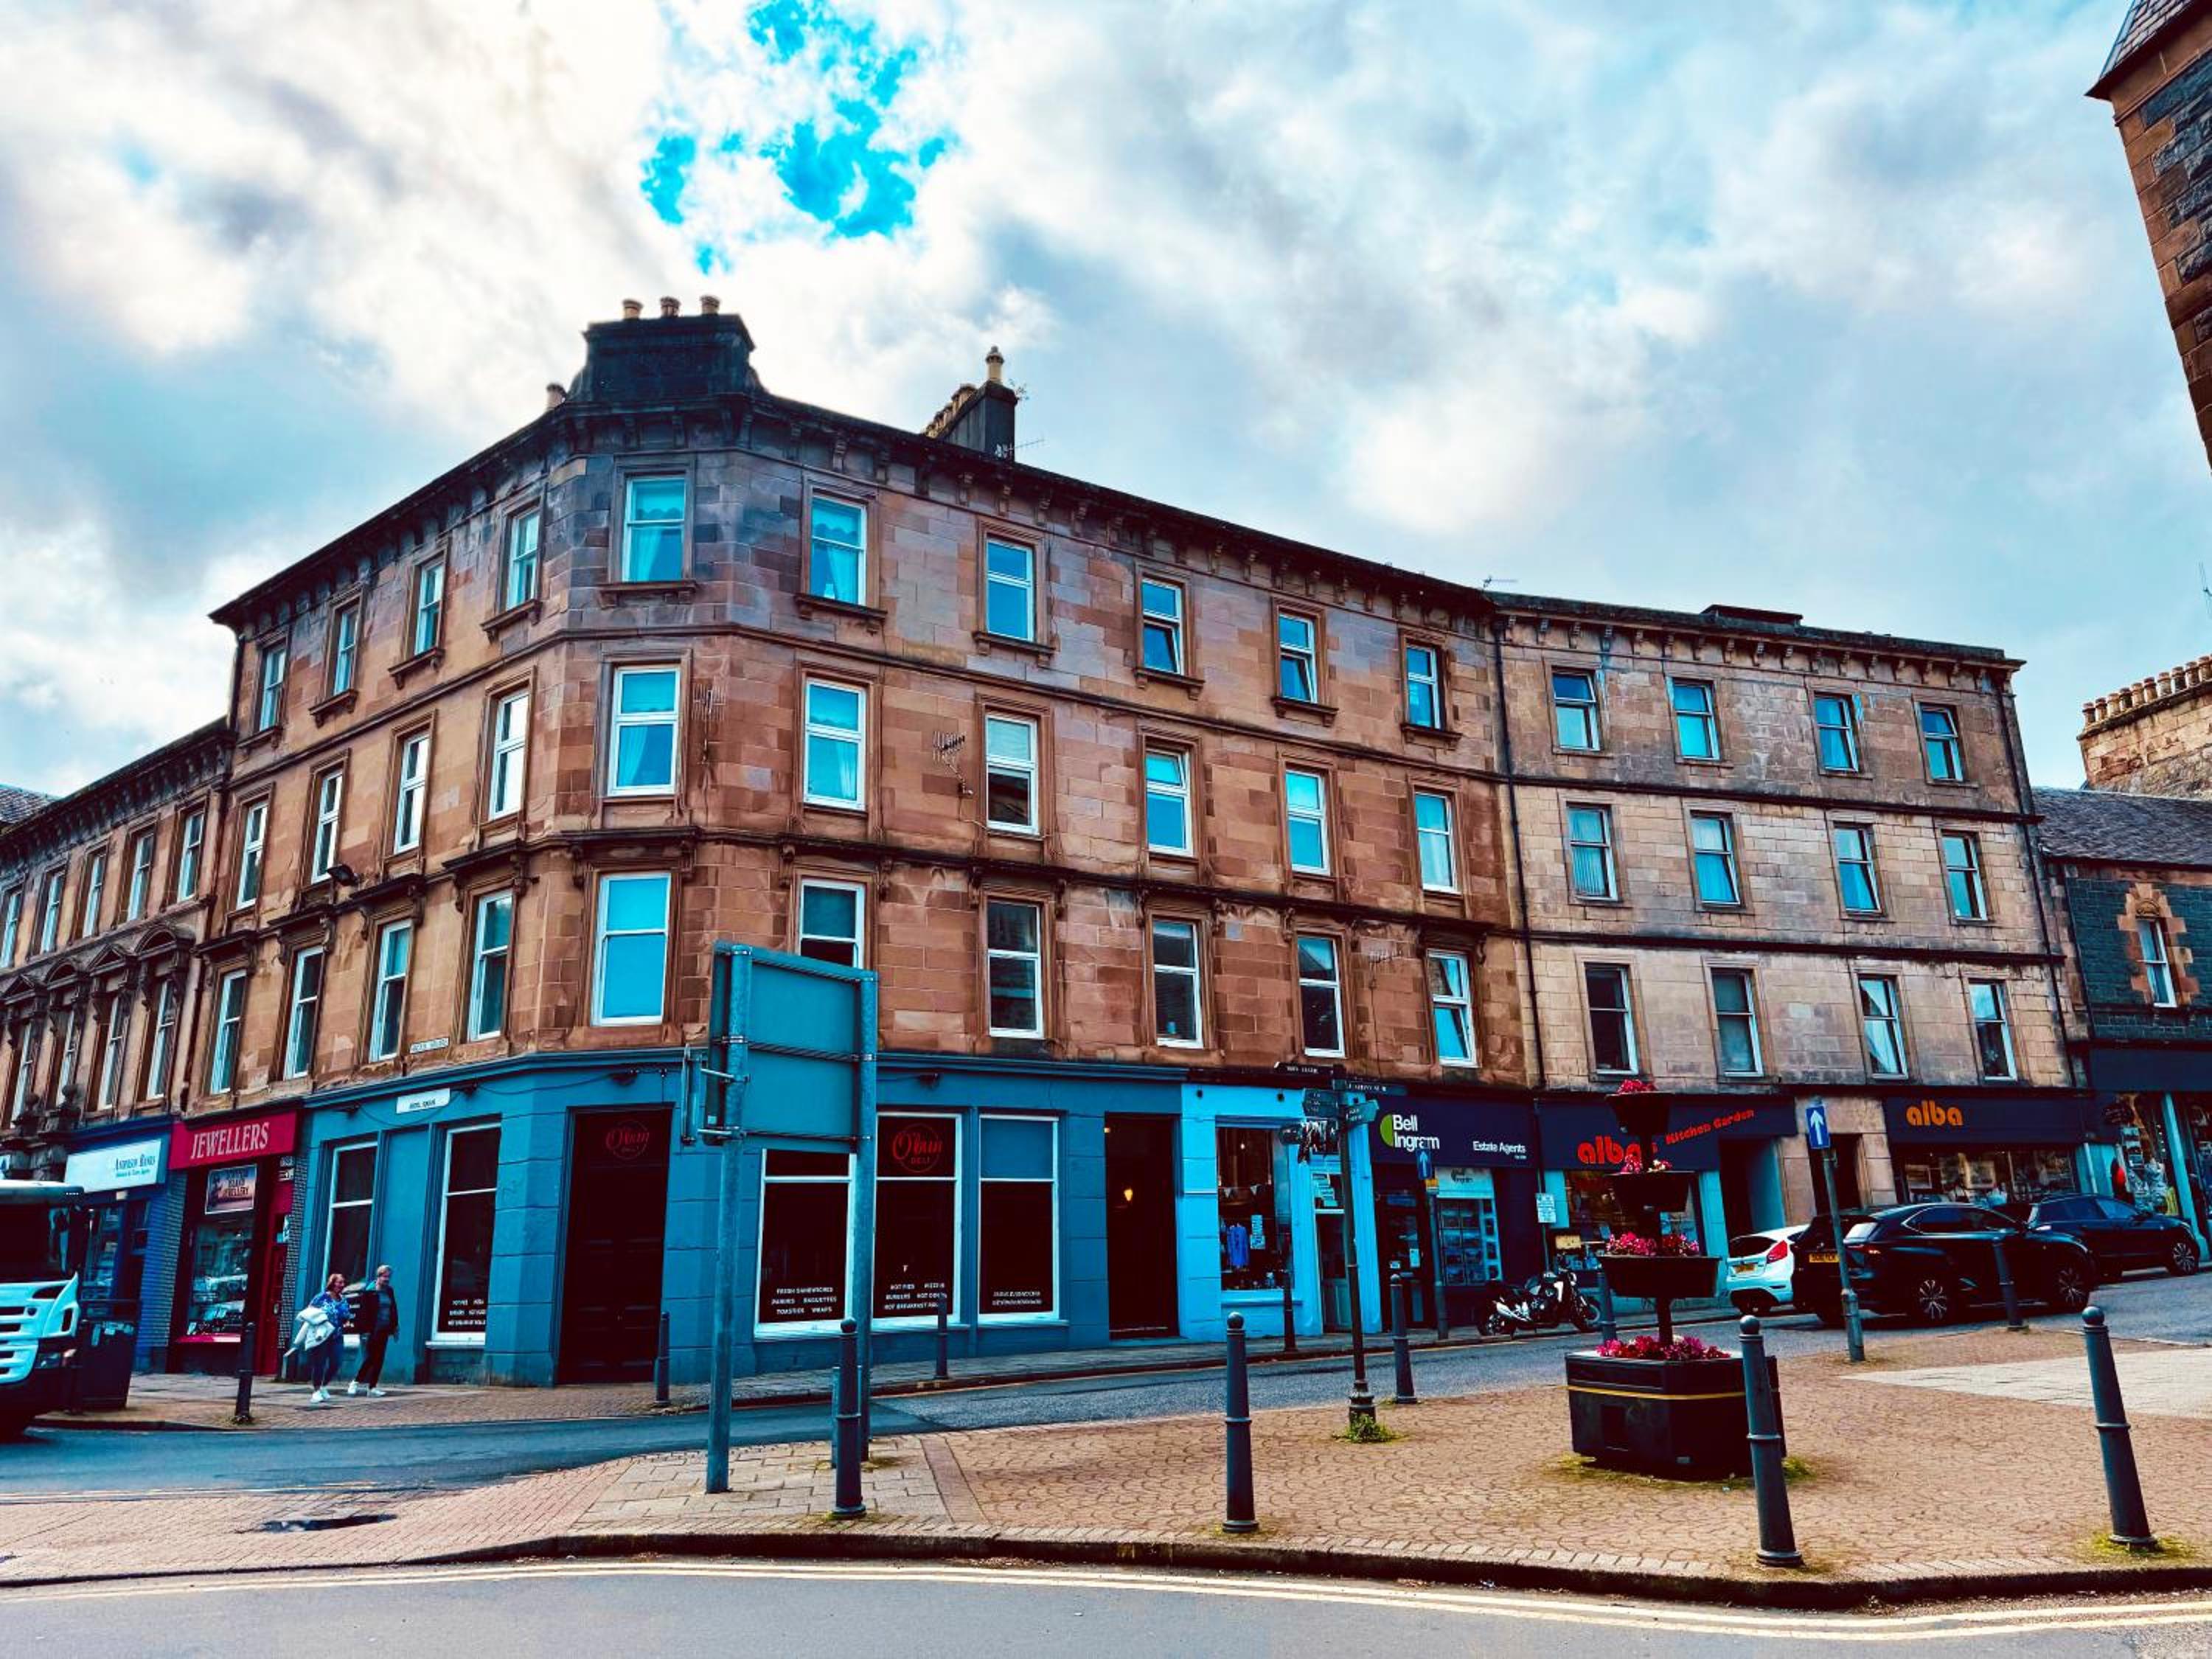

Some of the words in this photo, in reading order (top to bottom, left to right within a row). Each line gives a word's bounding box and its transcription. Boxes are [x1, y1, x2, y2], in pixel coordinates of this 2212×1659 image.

[1393, 1114, 1418, 1132] Bell
[1906, 1099, 1964, 1126] alba
[1666, 1123, 1711, 1145] Kitchen
[1713, 1108, 1755, 1129] Garden
[189, 1121, 270, 1160] JEWELLERS
[1394, 1131, 1440, 1152] Ingram
[1472, 1141, 1498, 1152] Estate
[1499, 1142, 1526, 1154] Agents
